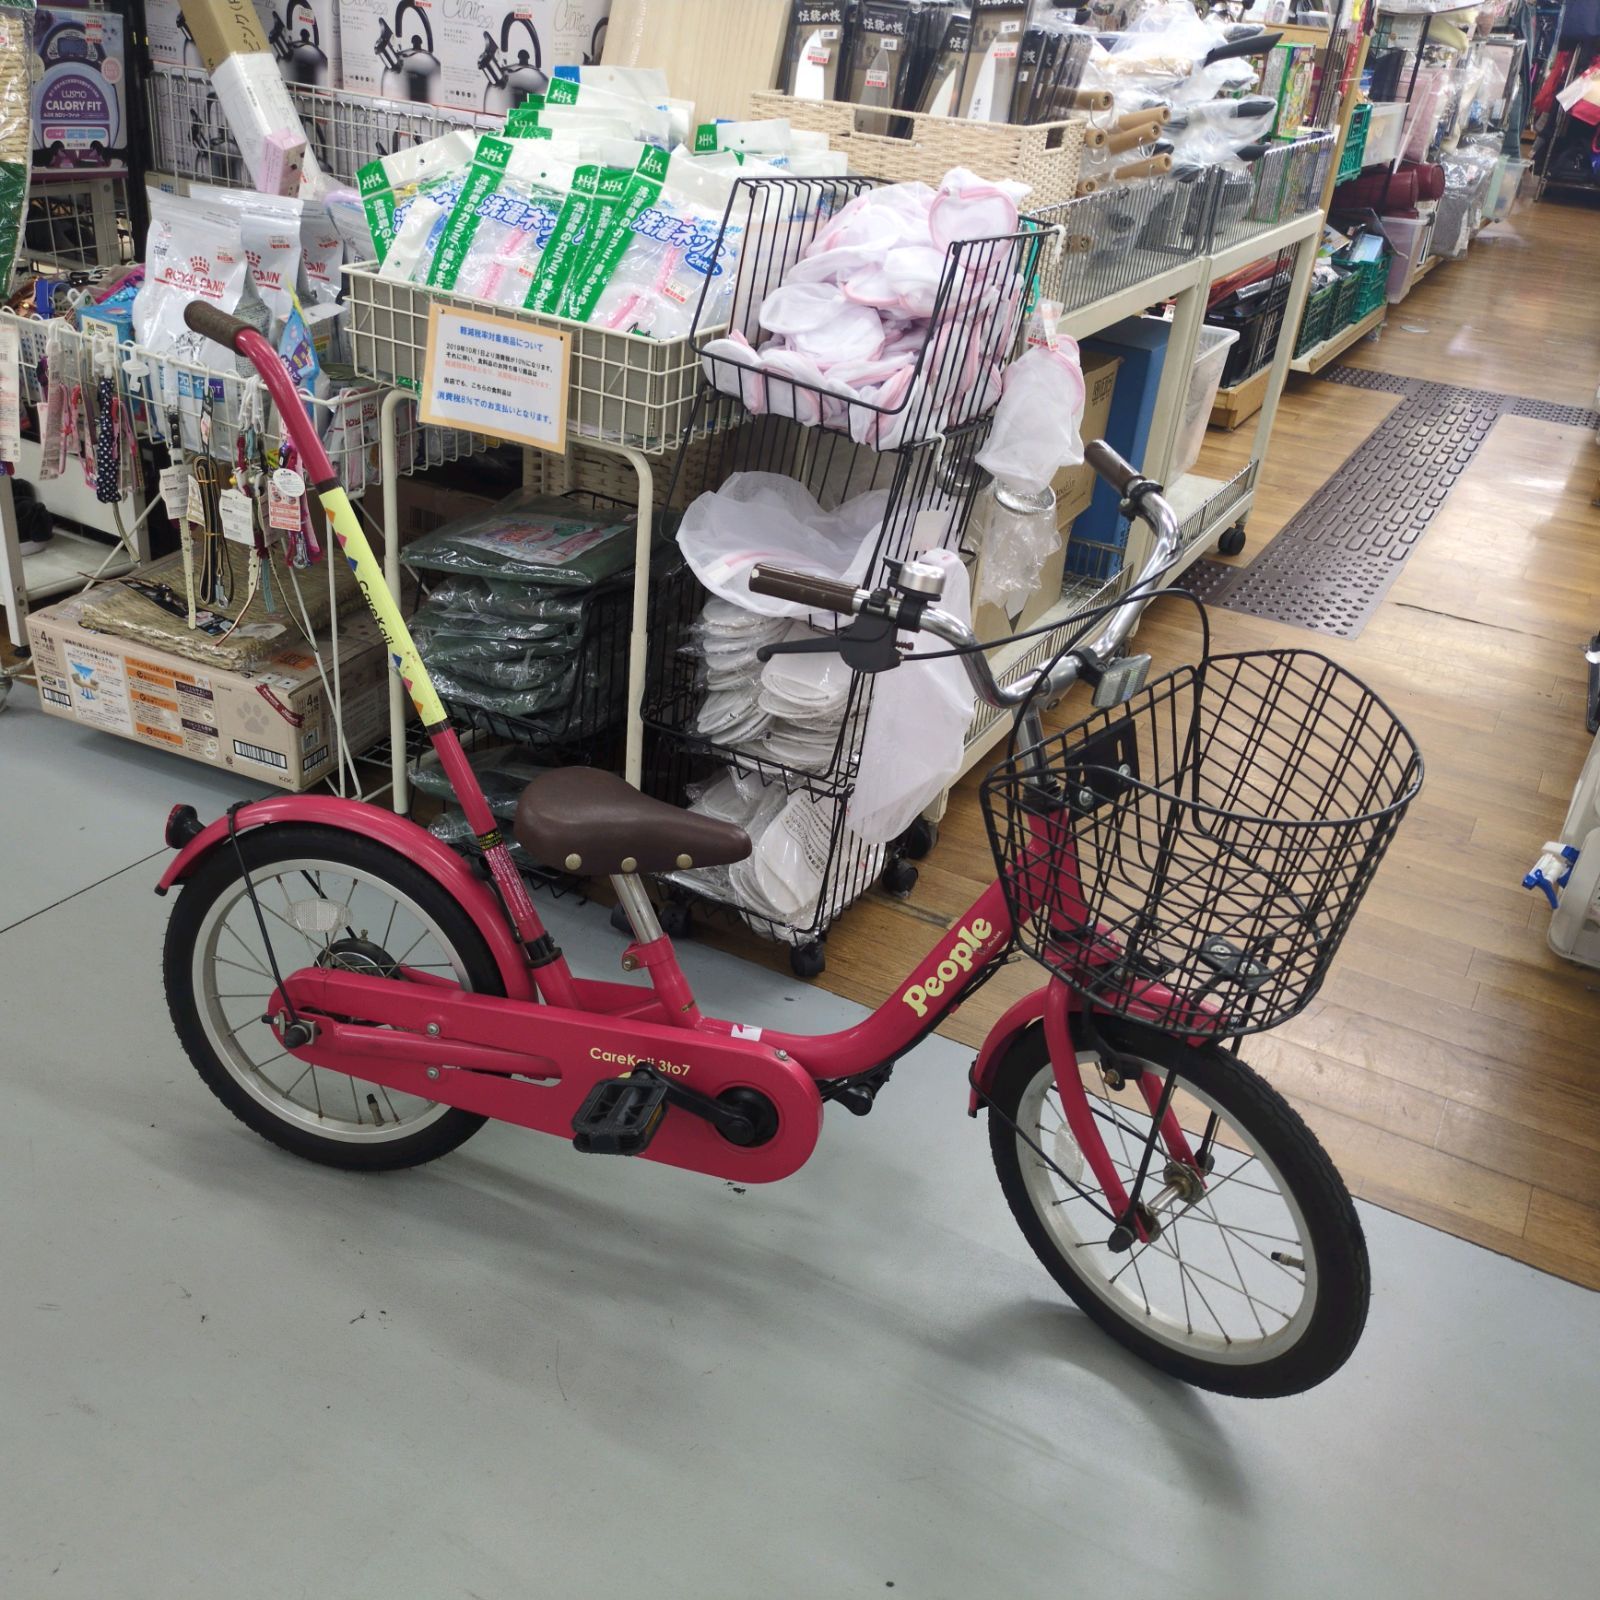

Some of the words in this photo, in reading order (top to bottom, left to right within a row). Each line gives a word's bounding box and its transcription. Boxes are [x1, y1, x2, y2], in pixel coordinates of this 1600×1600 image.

[45, 100, 86, 111] CALORY
[87, 101, 102, 111] FIT
[631, 208, 726, 257] 洗濯ネット
[460, 326, 544, 352] 軽減税率対象商品について
[437, 391, 552, 424] 消費税8%でのお支払いとなります。
[902, 917, 993, 1018] People
[658, 1058, 691, 1077] 3to7
